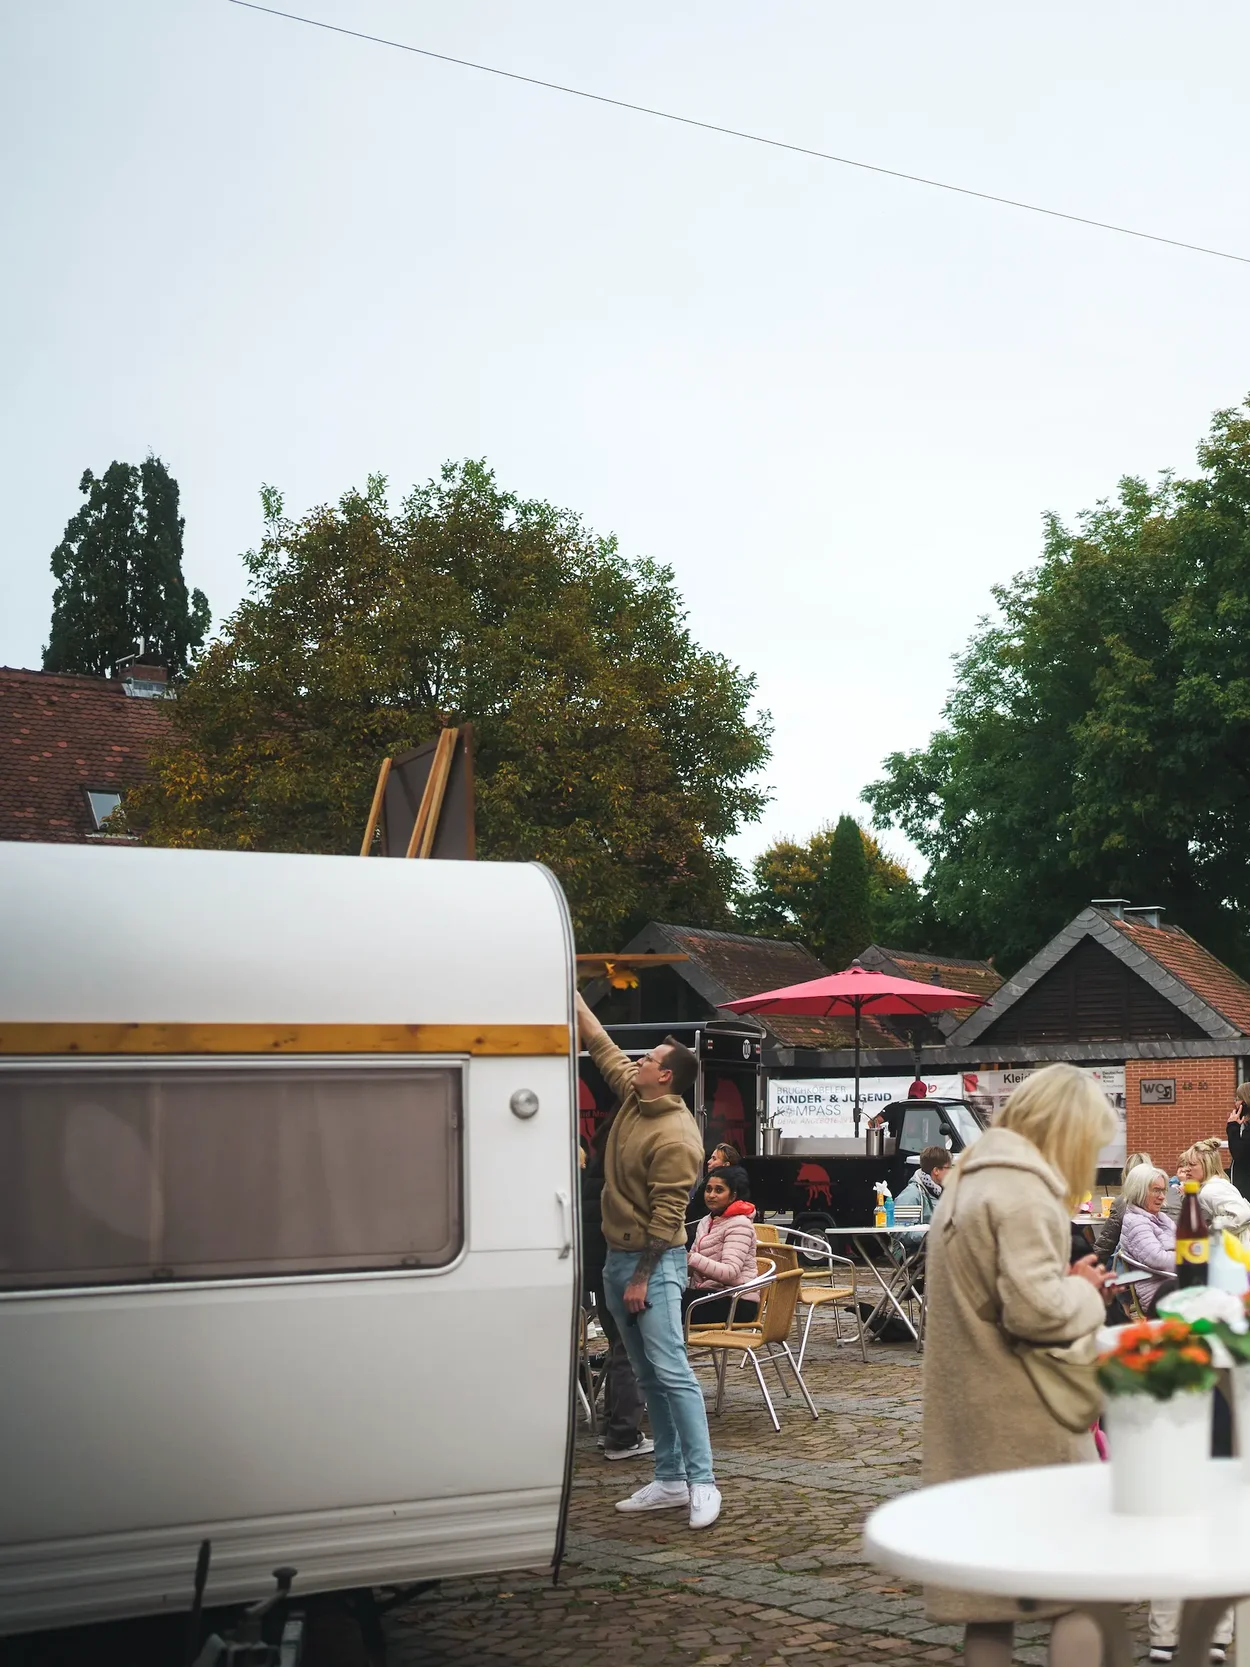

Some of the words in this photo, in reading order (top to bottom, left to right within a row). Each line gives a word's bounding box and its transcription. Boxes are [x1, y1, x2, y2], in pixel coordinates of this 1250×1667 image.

[776, 1086, 847, 1095] BRUCHKÖBELER
[1142, 1083, 1165, 1094] WC
[777, 1094, 826, 1104] KINDER-
[829, 1094, 839, 1103] &
[842, 1093, 892, 1103] JUGEND
